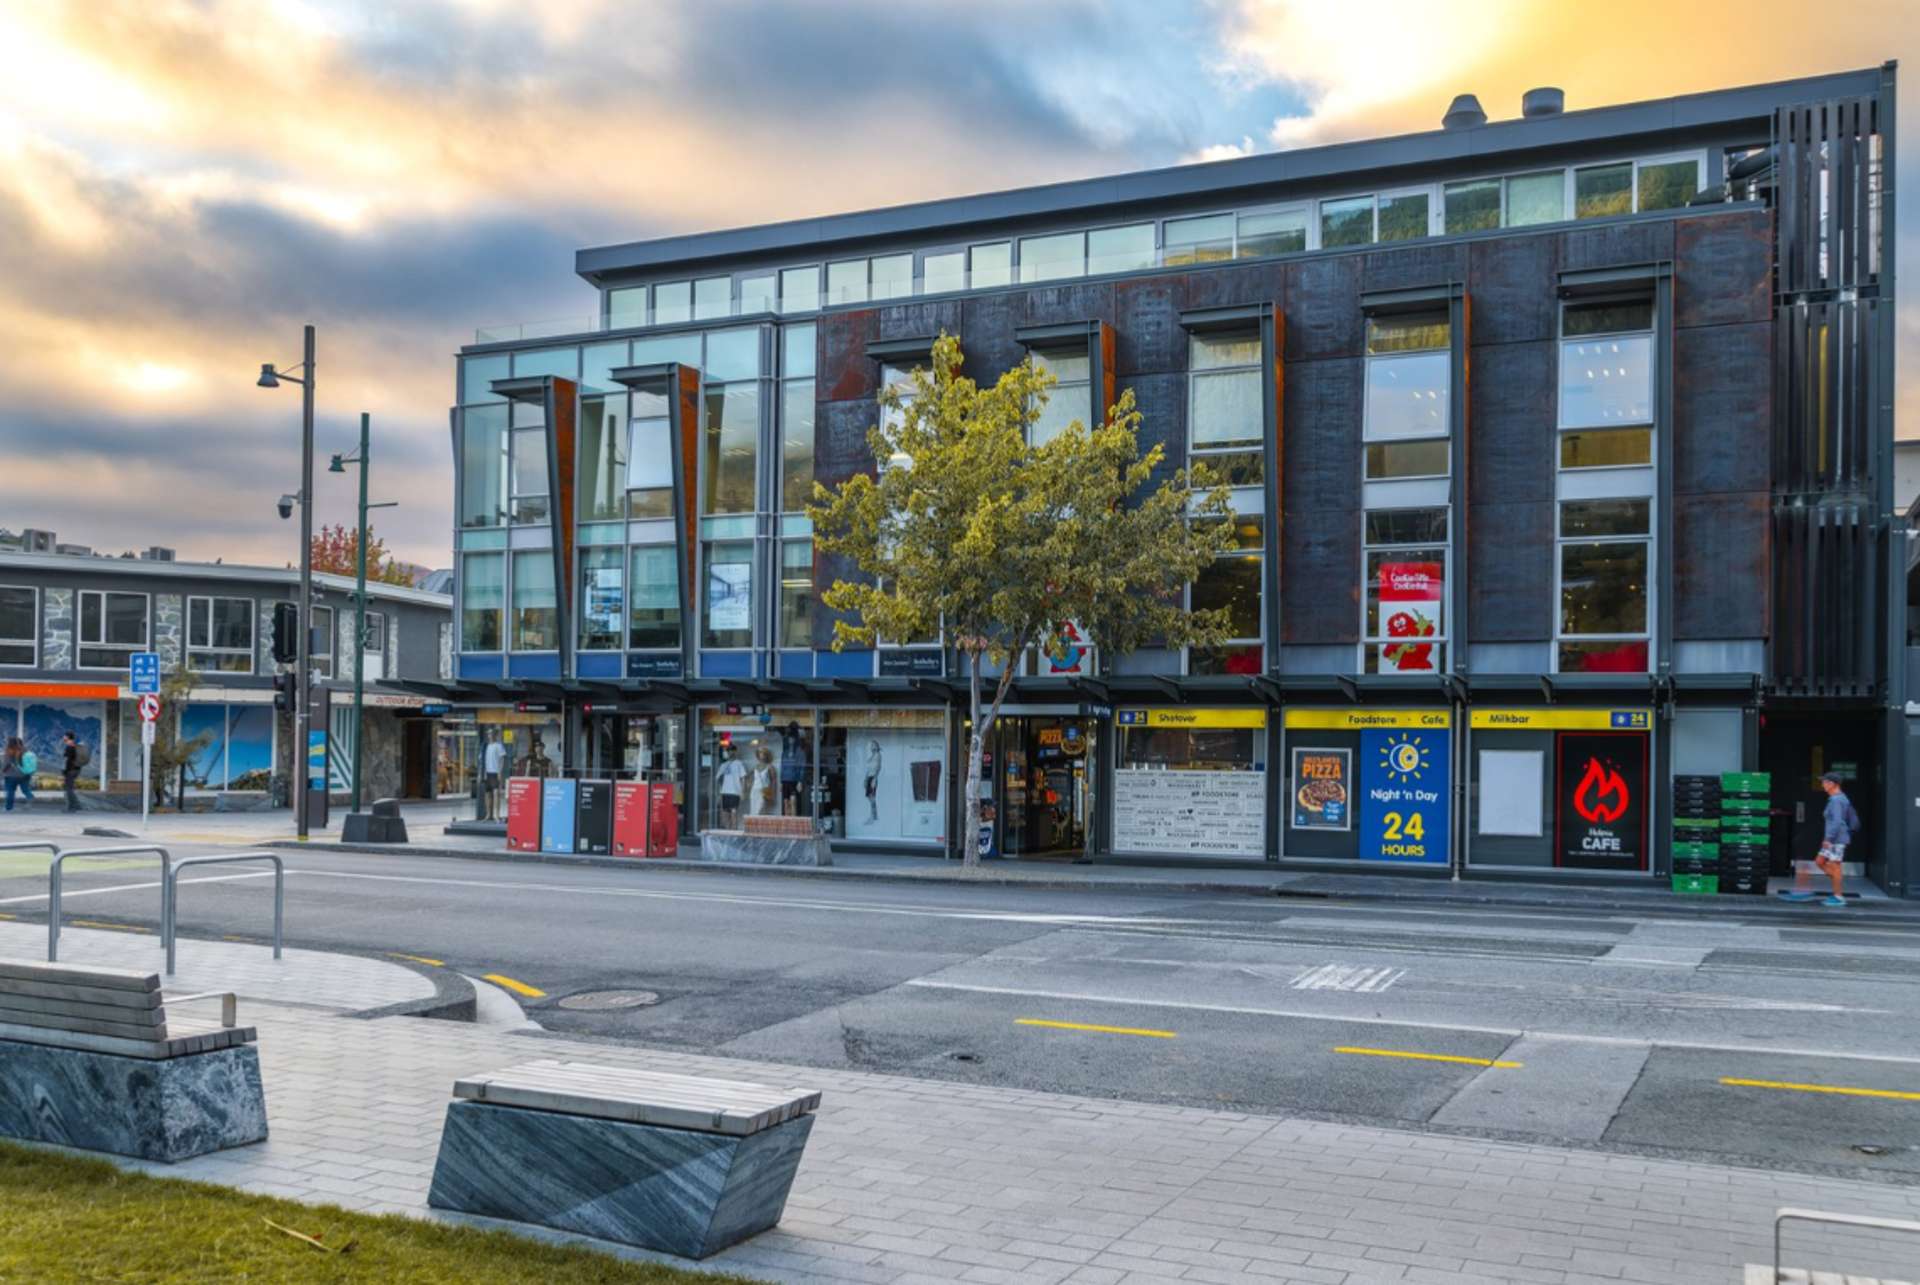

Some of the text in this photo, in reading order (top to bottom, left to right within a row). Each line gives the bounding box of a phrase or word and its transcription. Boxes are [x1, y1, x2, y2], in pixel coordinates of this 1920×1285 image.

[1348, 715, 1445, 724] Foodstore Cafe
[1488, 713, 1530, 723] Milkbar
[1302, 763, 1341, 779] PIZZA
[1370, 789, 1401, 802] Night
[1415, 790, 1438, 803] Day
[1383, 811, 1425, 841] 24
[1382, 844, 1425, 857] HOURS
[1582, 837, 1621, 851] CAFE
